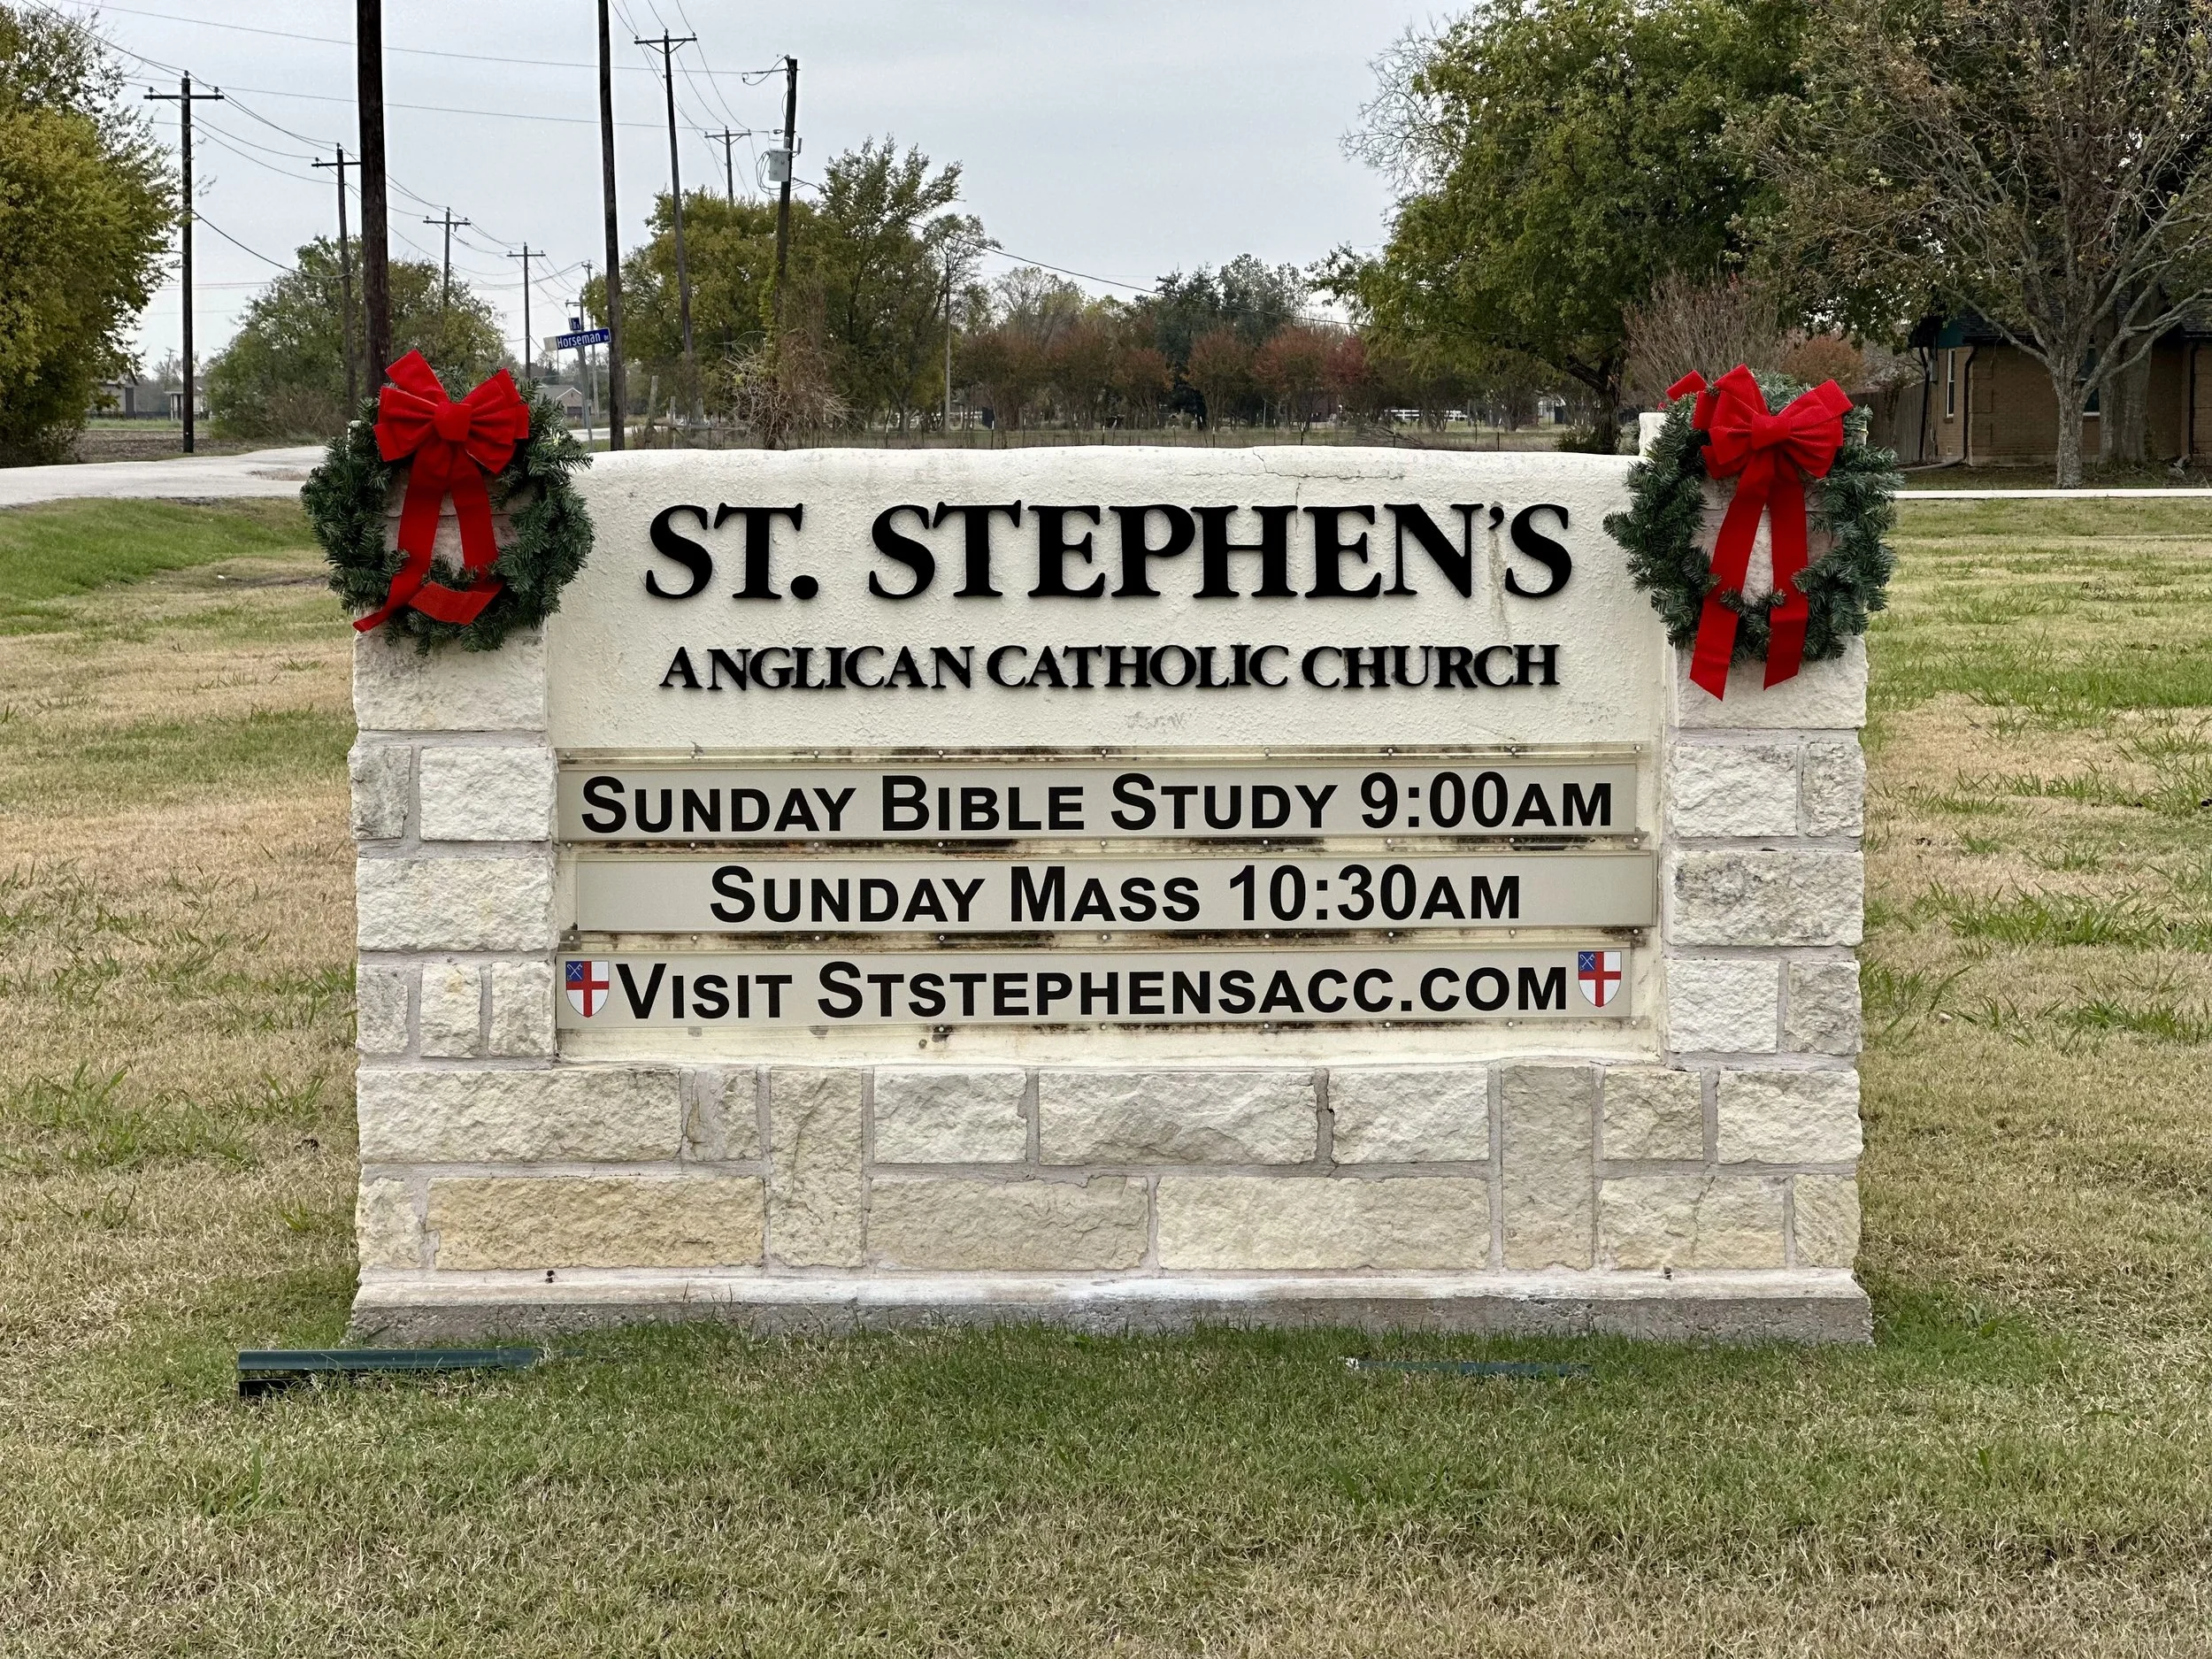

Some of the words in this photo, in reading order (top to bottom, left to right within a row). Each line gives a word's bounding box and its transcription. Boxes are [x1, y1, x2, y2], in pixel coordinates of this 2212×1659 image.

[557, 333, 601, 349] Horseman
[645, 502, 819, 602] ST.
[868, 499, 1572, 602] STEPHEN'S
[658, 645, 975, 692] ANGLICAN
[986, 644, 1289, 690] CATHOLIC
[1301, 643, 1561, 690] CHURCH
[1360, 771, 1611, 830] 9:00AM
[1230, 863, 1520, 922] 10:30AM
